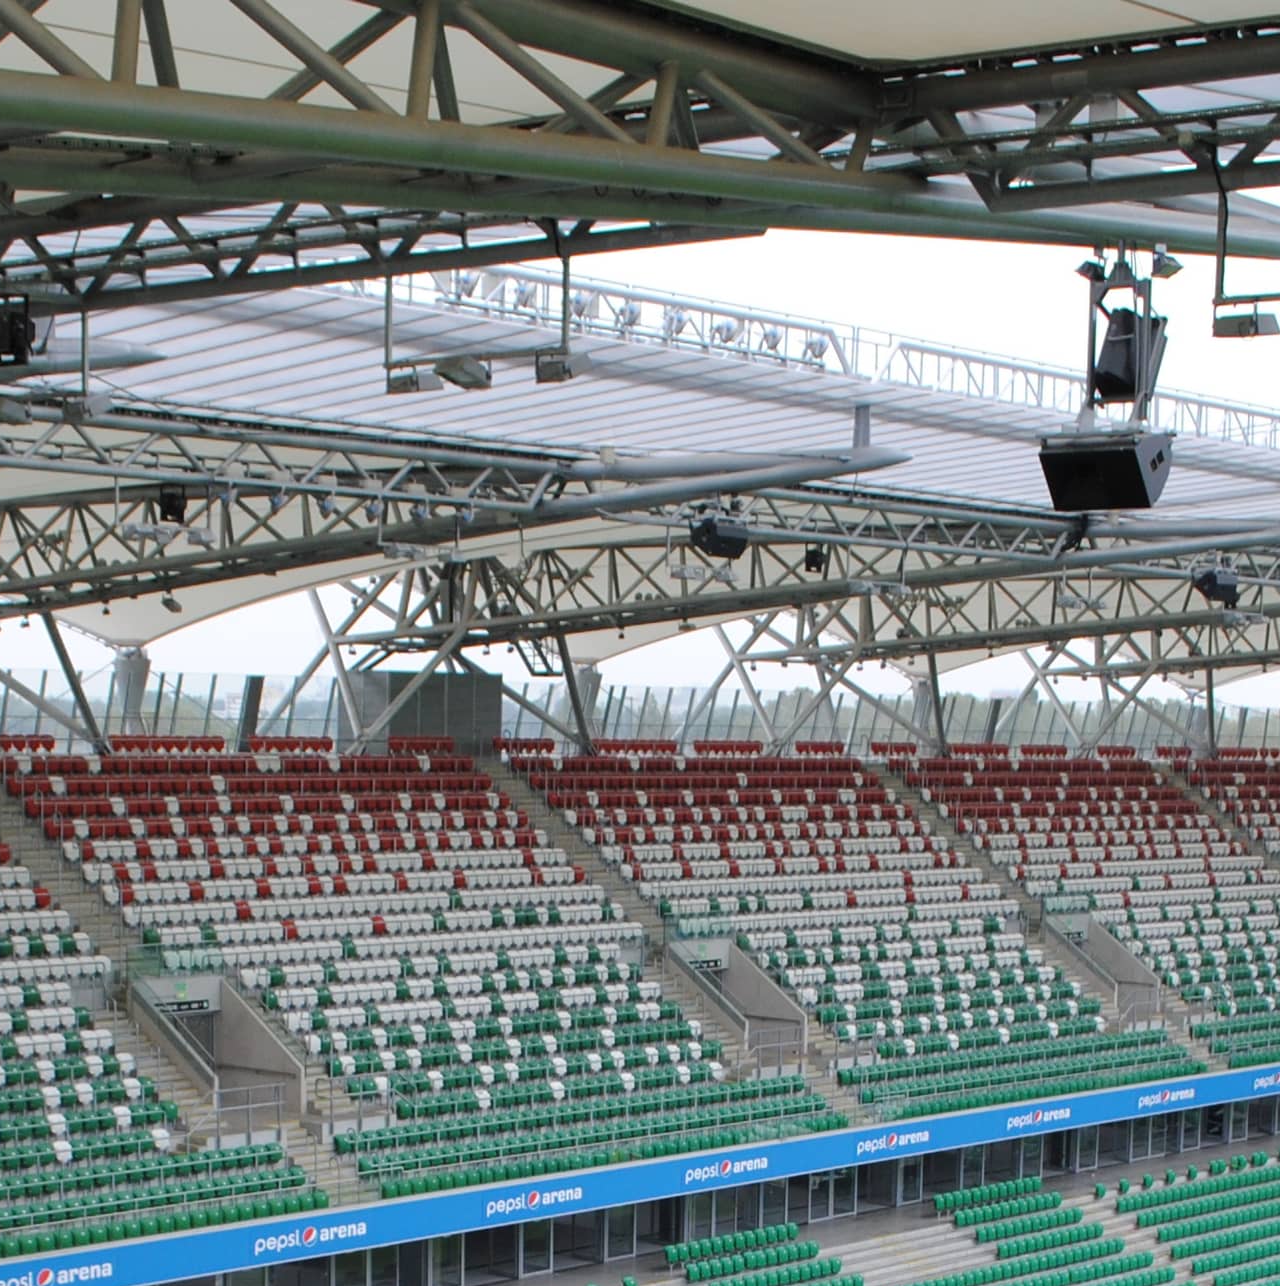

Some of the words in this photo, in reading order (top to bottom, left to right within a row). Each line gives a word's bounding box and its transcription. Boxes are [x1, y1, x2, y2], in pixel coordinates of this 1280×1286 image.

[1006, 1111, 1033, 1131] pepsi
[1043, 1107, 1071, 1122] arena
[856, 1135, 887, 1156] pepsi
[898, 1131, 929, 1146] arena
[685, 1162, 720, 1185] pepsi
[733, 1157, 768, 1174] arena
[486, 1193, 527, 1218] pepsi
[542, 1186, 583, 1205] arena
[254, 1229, 301, 1257] pepsi
[320, 1221, 367, 1241] arena
[57, 1262, 113, 1285] arena
